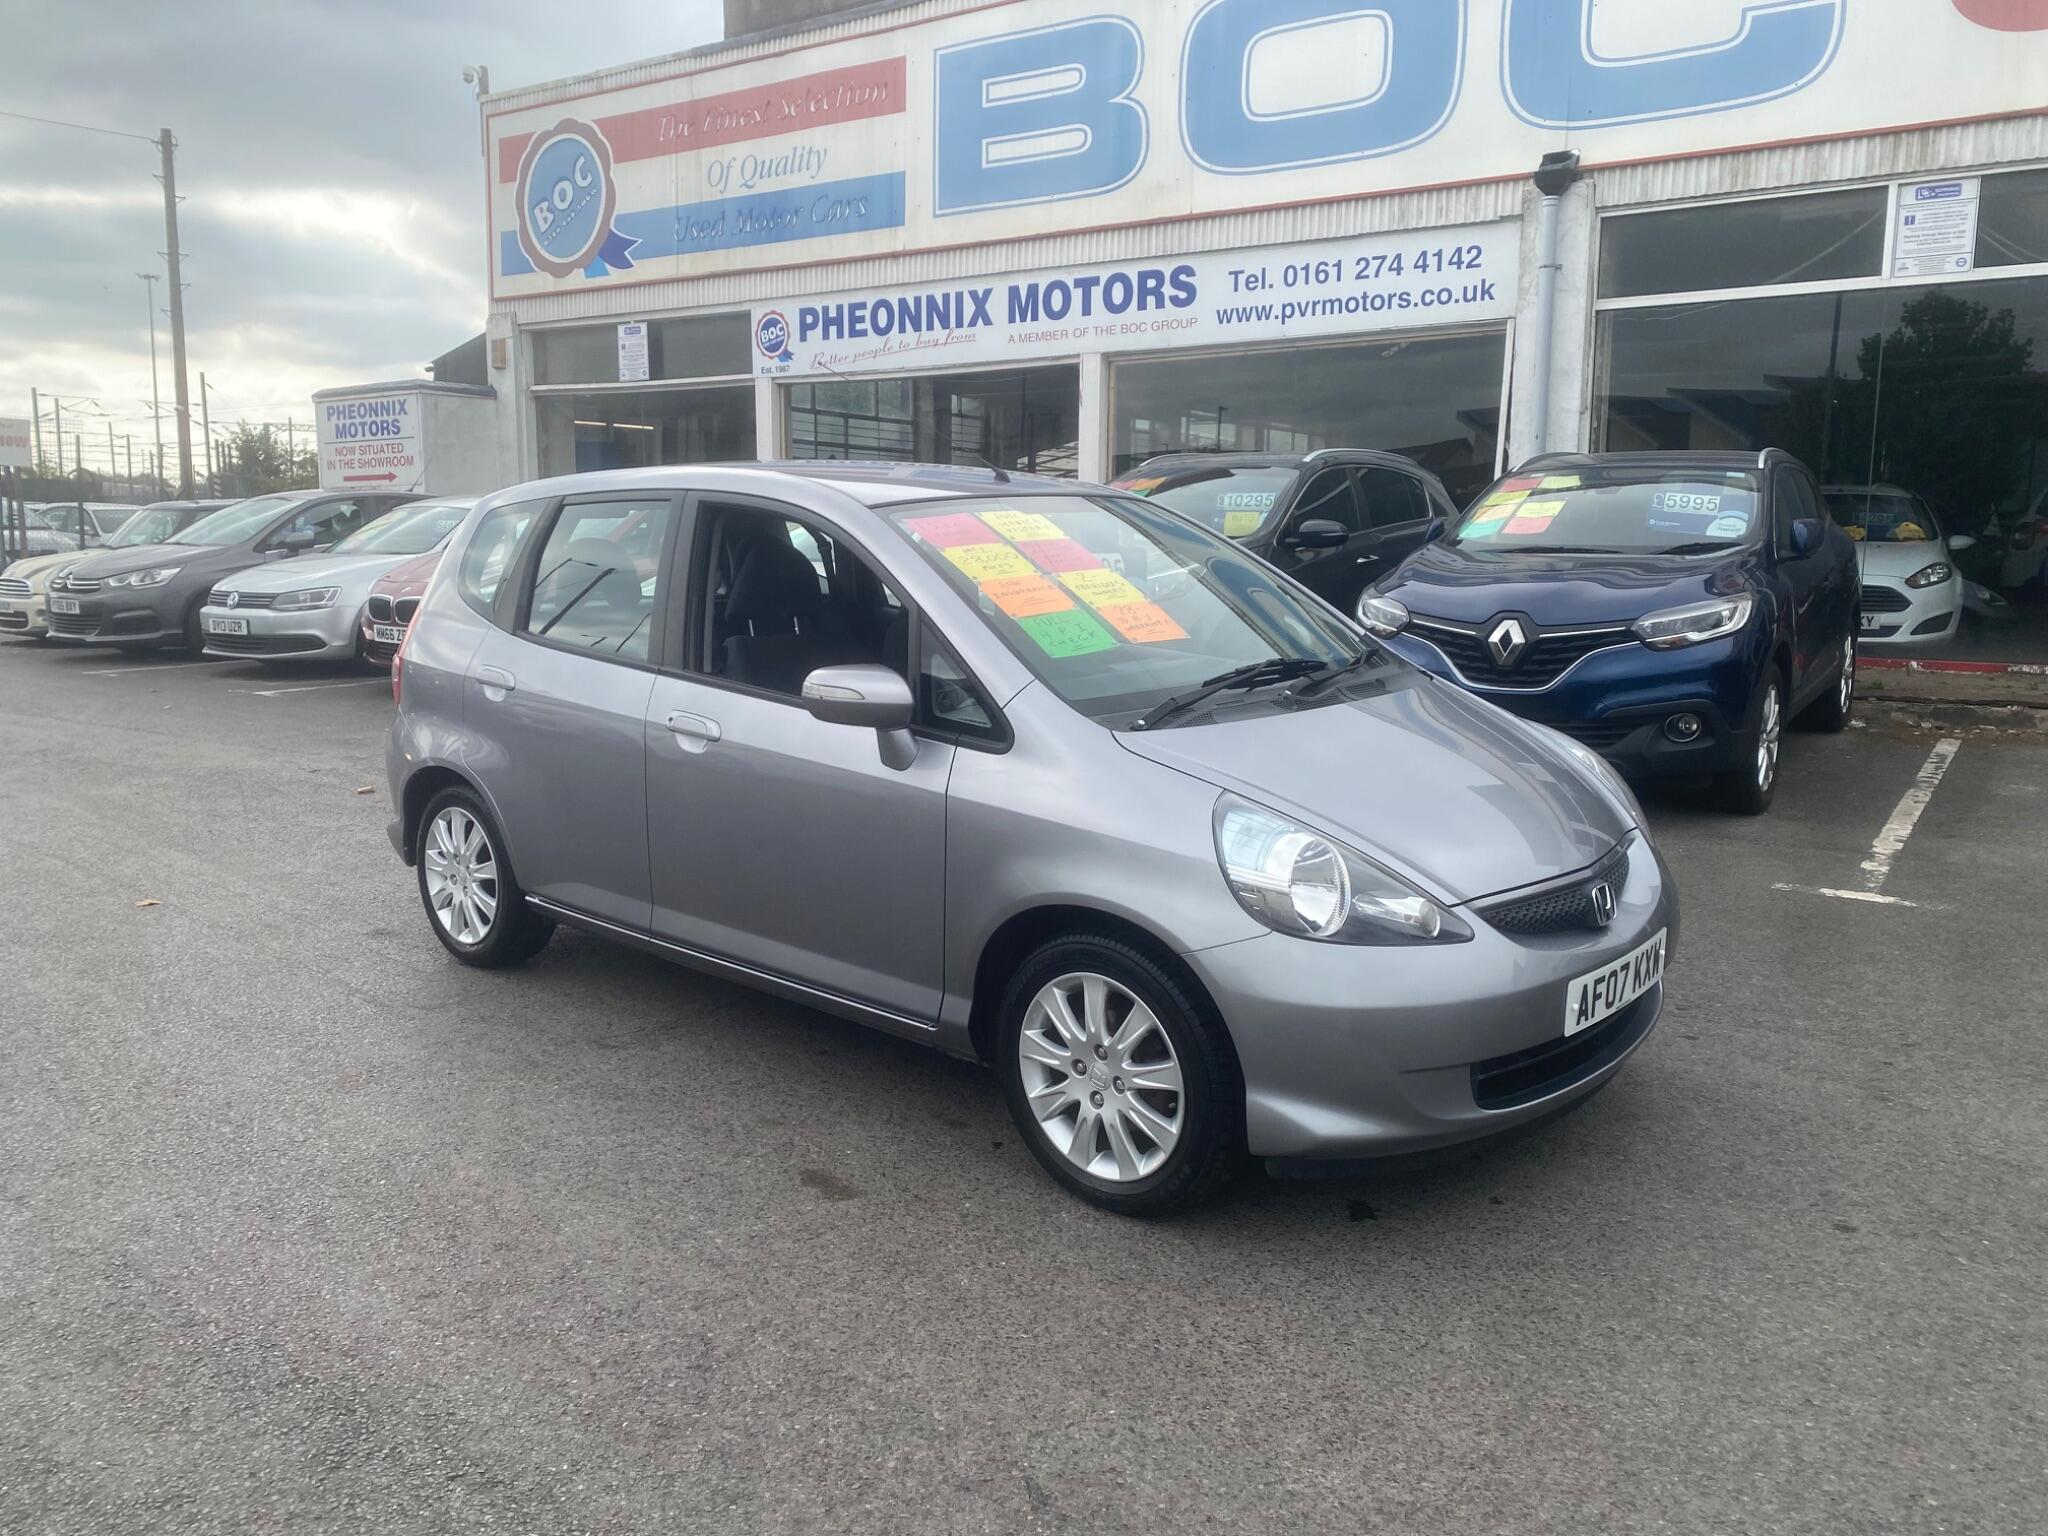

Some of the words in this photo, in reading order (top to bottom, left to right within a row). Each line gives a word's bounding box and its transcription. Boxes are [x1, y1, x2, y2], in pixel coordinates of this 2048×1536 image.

[657, 115, 694, 142] The
[702, 100, 772, 134] Finest
[777, 80, 889, 121] Selection
[707, 156, 737, 194] Of
[739, 145, 828, 190] Quality
[533, 155, 593, 234] BOC
[673, 210, 726, 243] Used
[730, 204, 805, 238] Motor
[811, 193, 870, 225] Cars
[1228, 266, 1274, 293] Tel.
[1283, 258, 1343, 289] 0161
[1354, 253, 1404, 281] 274
[1413, 244, 1483, 275] 4142
[799, 287, 993, 342] PHEONNIX
[1008, 264, 1198, 323] MOTORS
[1216, 278, 1496, 326] www.pvrmotors.co.uk
[760, 324, 785, 344] BOC
[810, 351, 849, 371] Better
[852, 336, 894, 363] people
[898, 338, 911, 350] to
[915, 331, 940, 350] buy
[944, 326, 977, 348] from
[1008, 334, 1016, 344] A
[1019, 329, 1069, 343] MEMBER
[1073, 326, 1089, 339] OF
[1093, 324, 1117, 337] THE
[1121, 321, 1147, 335] BOC
[1150, 317, 1198, 332] GROUP
[326, 398, 408, 422] PHEONNIX
[335, 418, 401, 439] MOTORS
[327, 460, 336, 471] IN
[338, 459, 356, 470] THE
[358, 455, 414, 469] SHOWROOM
[335, 445, 356, 457] NOW
[358, 442, 404, 456] SITUATED
[1651, 492, 1719, 512] £5995
[212, 619, 227, 632] DY13
[227, 620, 243, 633] UZR
[1576, 960, 1631, 1026] AF07
[1632, 937, 1661, 994] KXW
